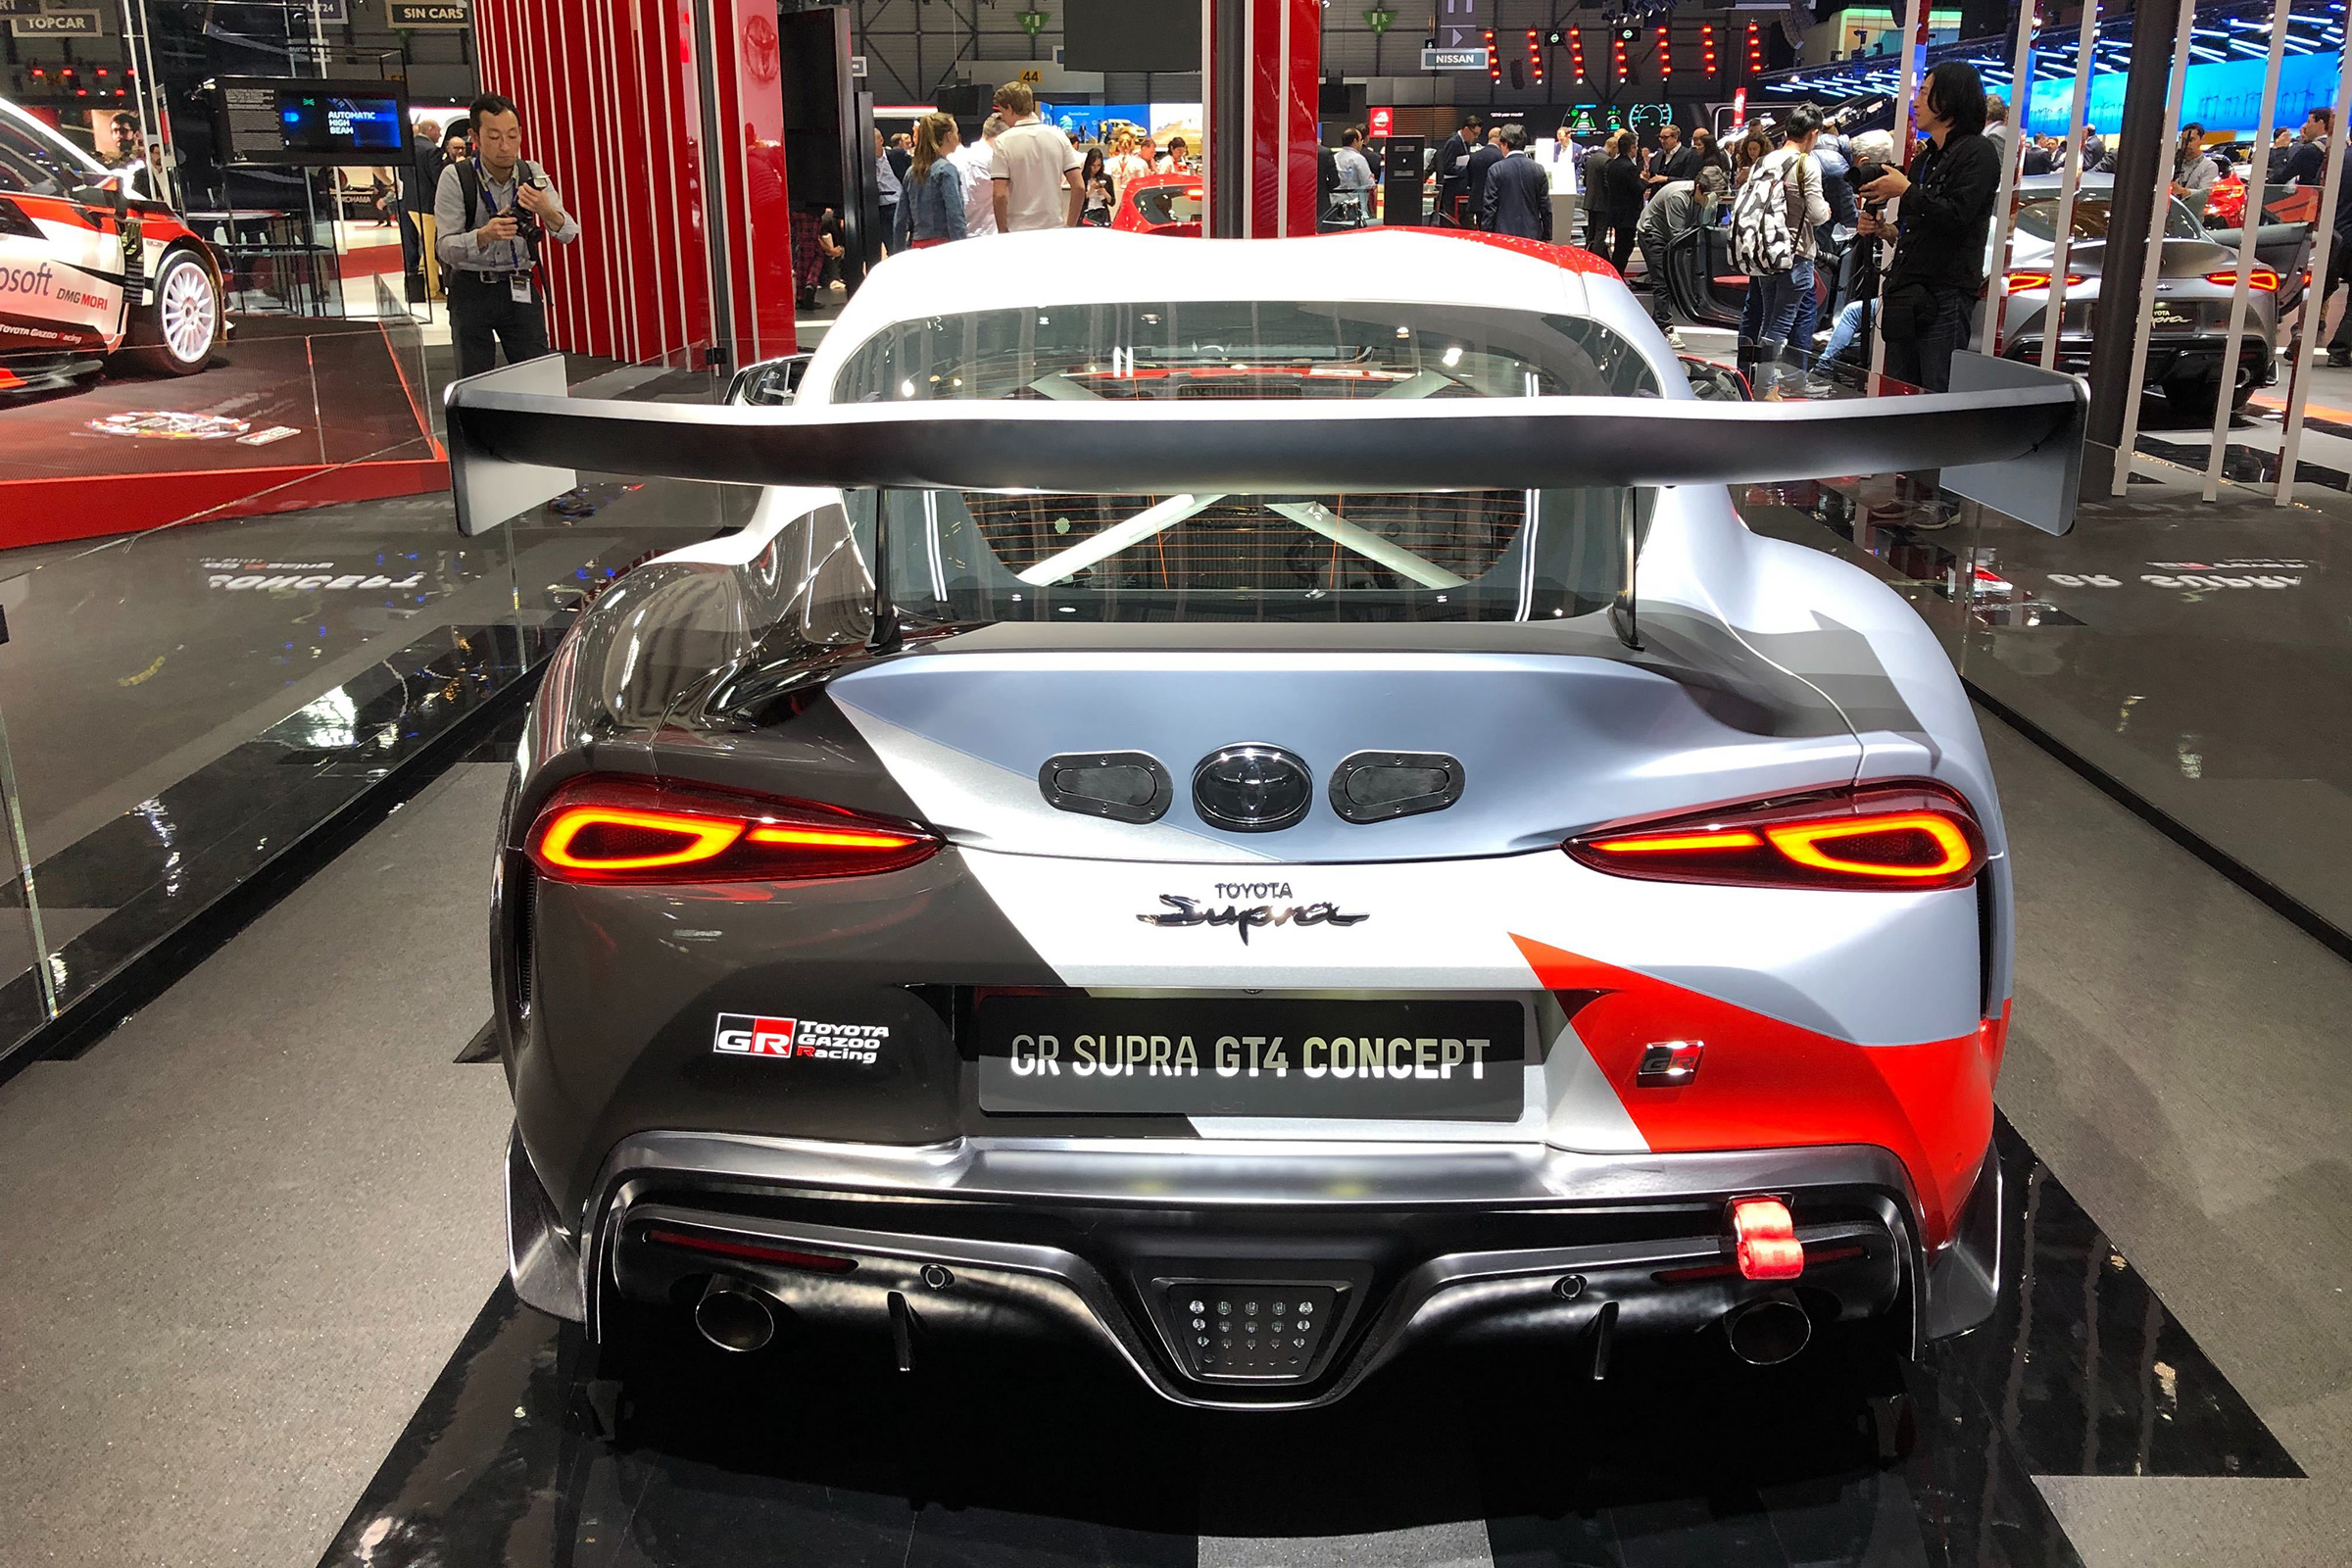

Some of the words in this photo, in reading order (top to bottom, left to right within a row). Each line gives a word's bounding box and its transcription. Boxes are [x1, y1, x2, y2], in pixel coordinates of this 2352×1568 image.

[404, 8, 425, 19] SIN
[428, 8, 464, 19] CARS
[26, 17, 85, 29] TOPCAR
[1436, 54, 1475, 64] NISSAN
[1022, 71, 1039, 82] 44
[328, 111, 376, 120] AUTOMATIC
[56, 288, 81, 304] DMG
[80, 293, 108, 311] MORI
[1214, 882, 1294, 899] TOYOTA
[1136, 894, 1371, 947] Supra
[799, 1020, 890, 1038] TOYOTA
[717, 1029, 790, 1054] GR
[797, 1033, 881, 1049] GAZOO
[796, 1046, 877, 1064] Racing
[1010, 1035, 1061, 1075] GR
[1072, 1035, 1200, 1077] SUPRA
[1214, 1036, 1290, 1078] GT4
[1302, 1036, 1491, 1080] CONCEPT
[1642, 1055, 1695, 1073] GR
